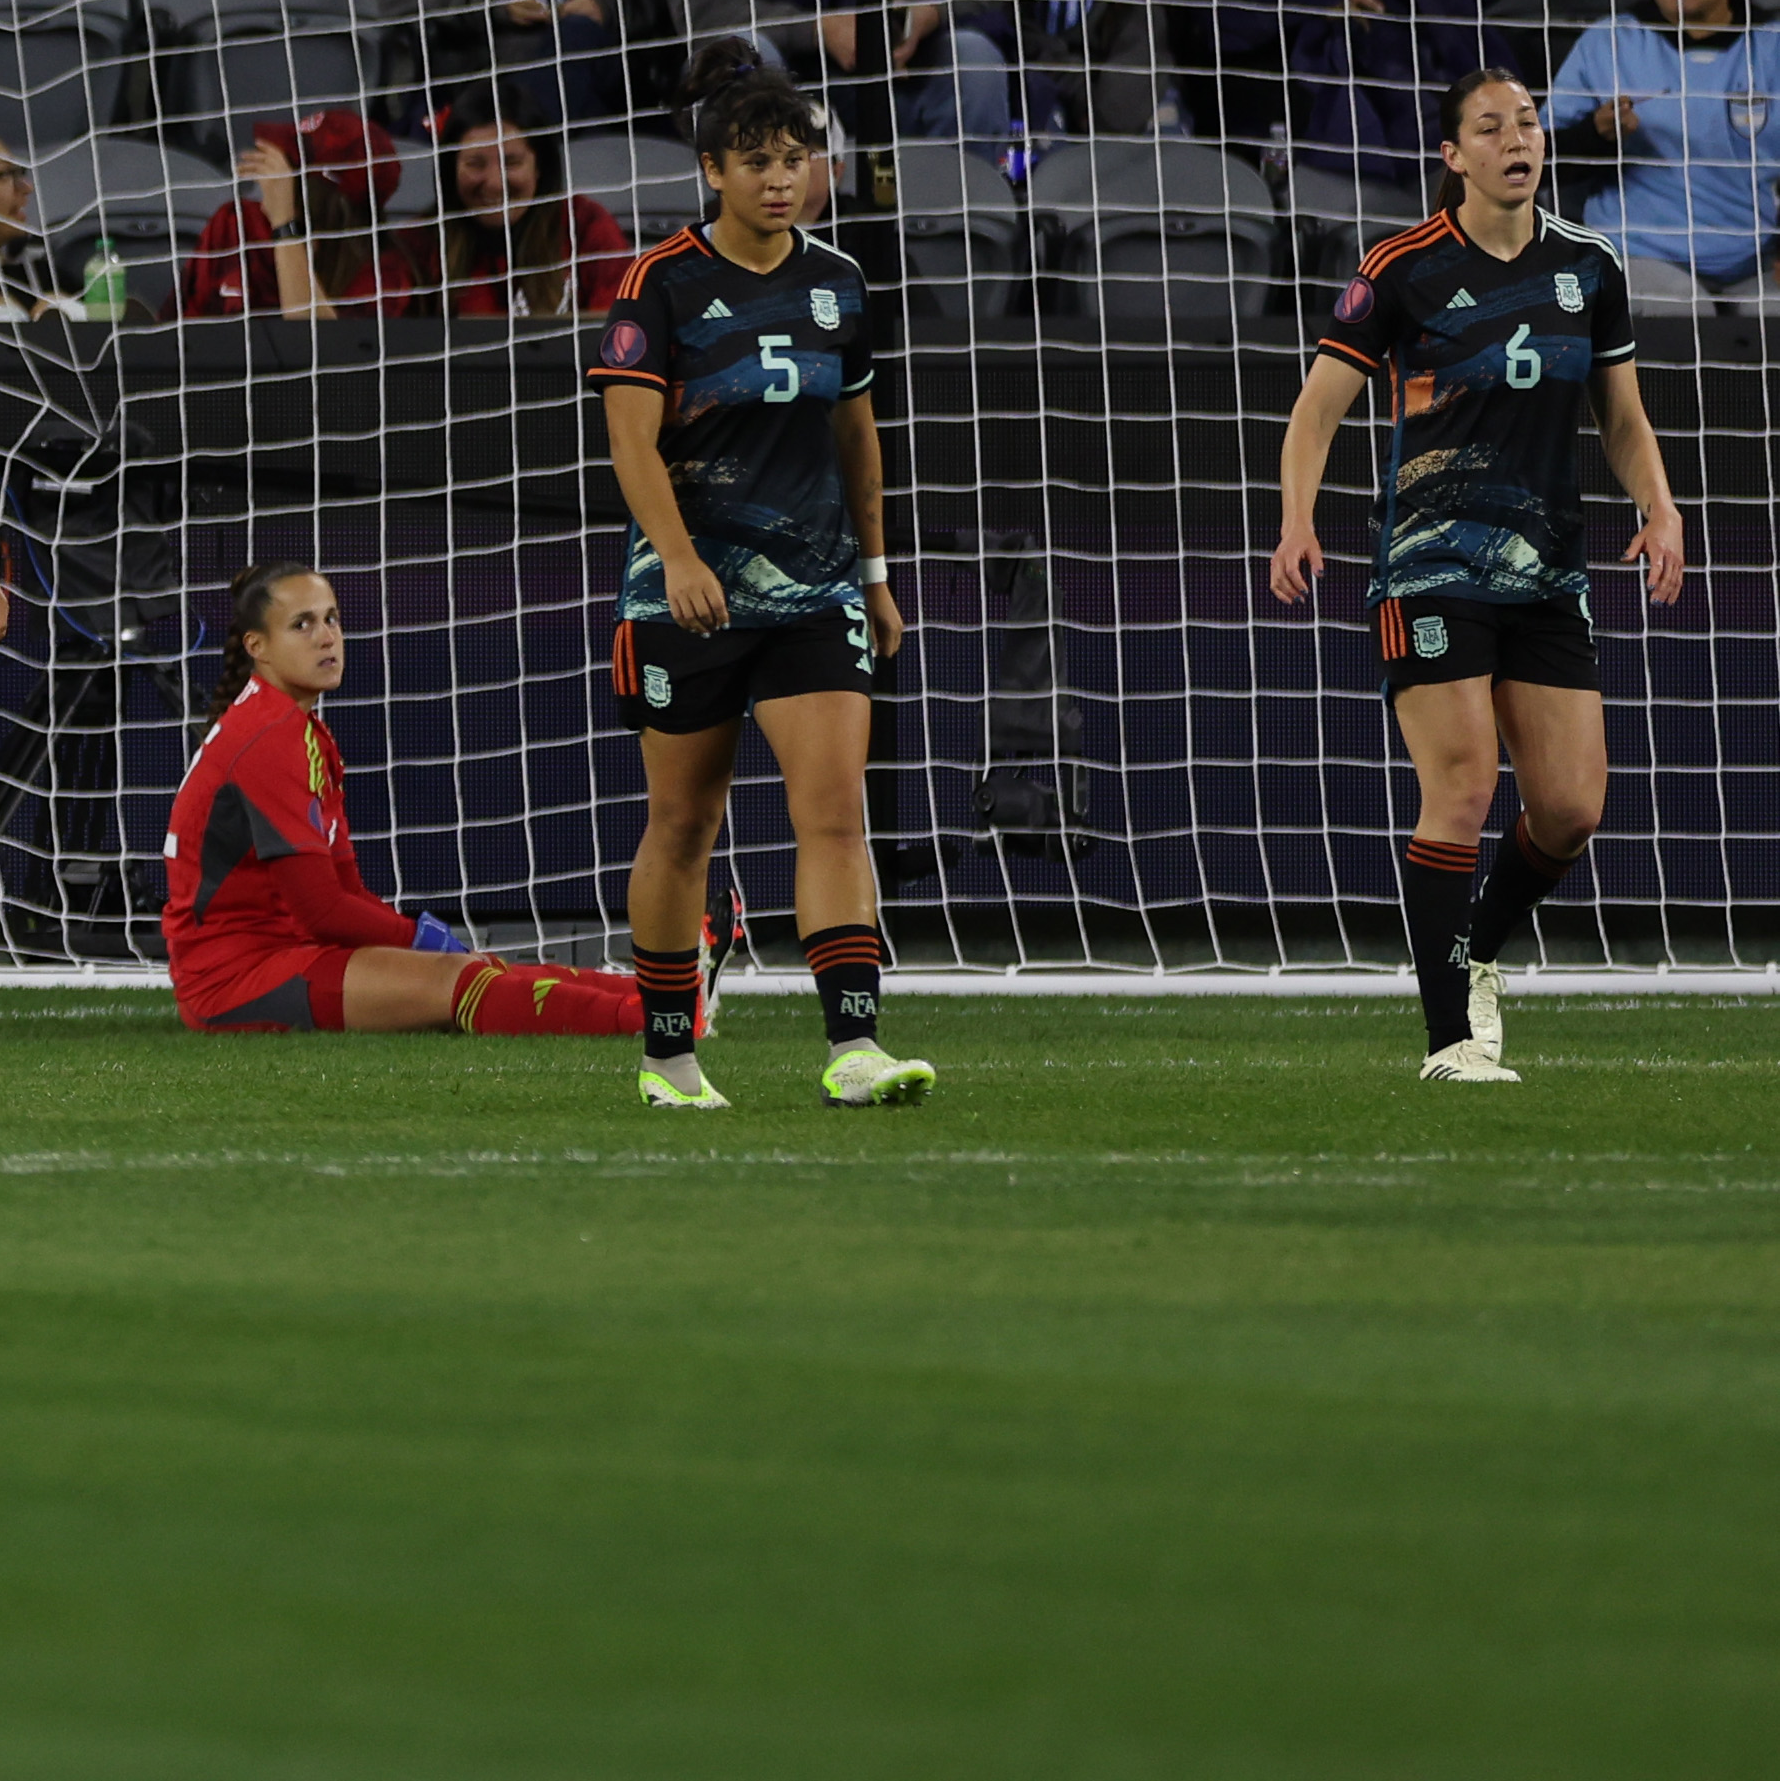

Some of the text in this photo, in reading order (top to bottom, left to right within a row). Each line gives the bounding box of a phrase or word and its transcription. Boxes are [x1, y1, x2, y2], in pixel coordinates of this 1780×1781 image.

[757, 333, 801, 404] 5
[1505, 323, 1542, 390] 6
[651, 1011, 692, 1037] AFA
[840, 988, 877, 1018] AFA
